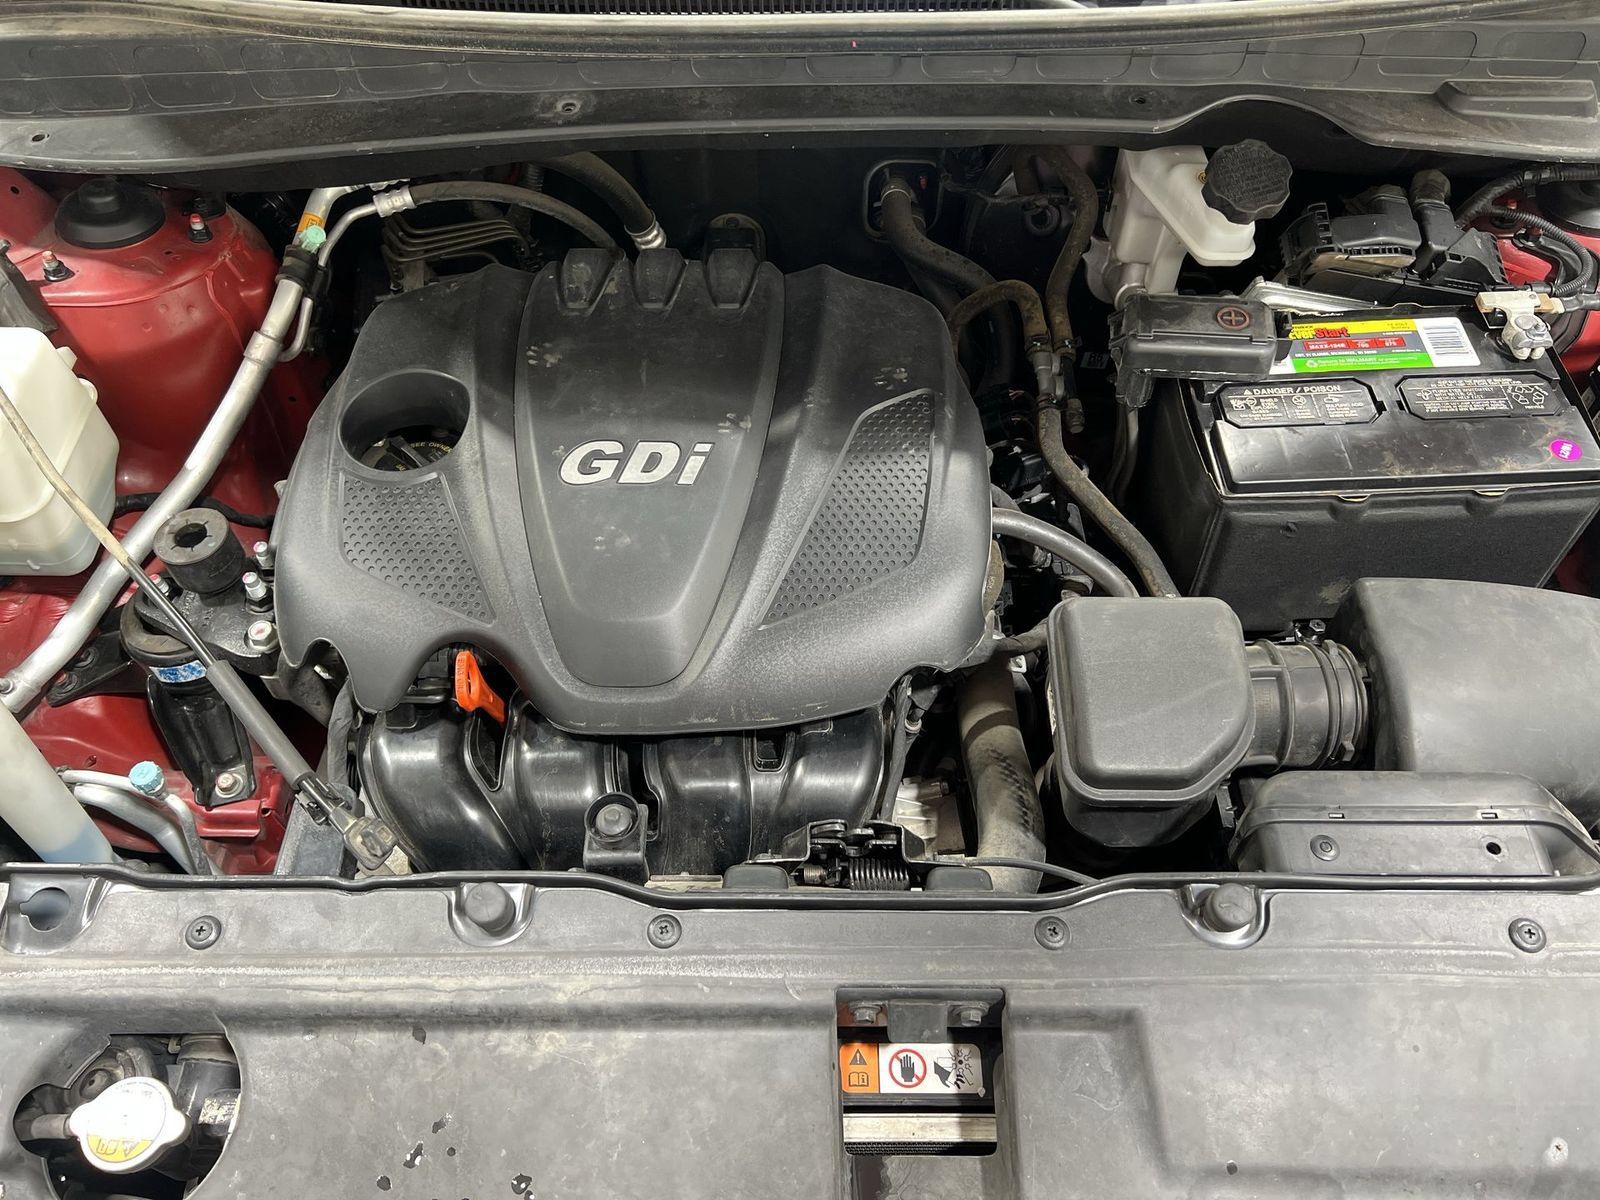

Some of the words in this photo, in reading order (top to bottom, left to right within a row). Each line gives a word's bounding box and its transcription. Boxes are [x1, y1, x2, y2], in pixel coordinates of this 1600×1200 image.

[1253, 387, 1294, 395] DANGER
[1303, 385, 1341, 393] POISON
[560, 440, 714, 485] GDi
